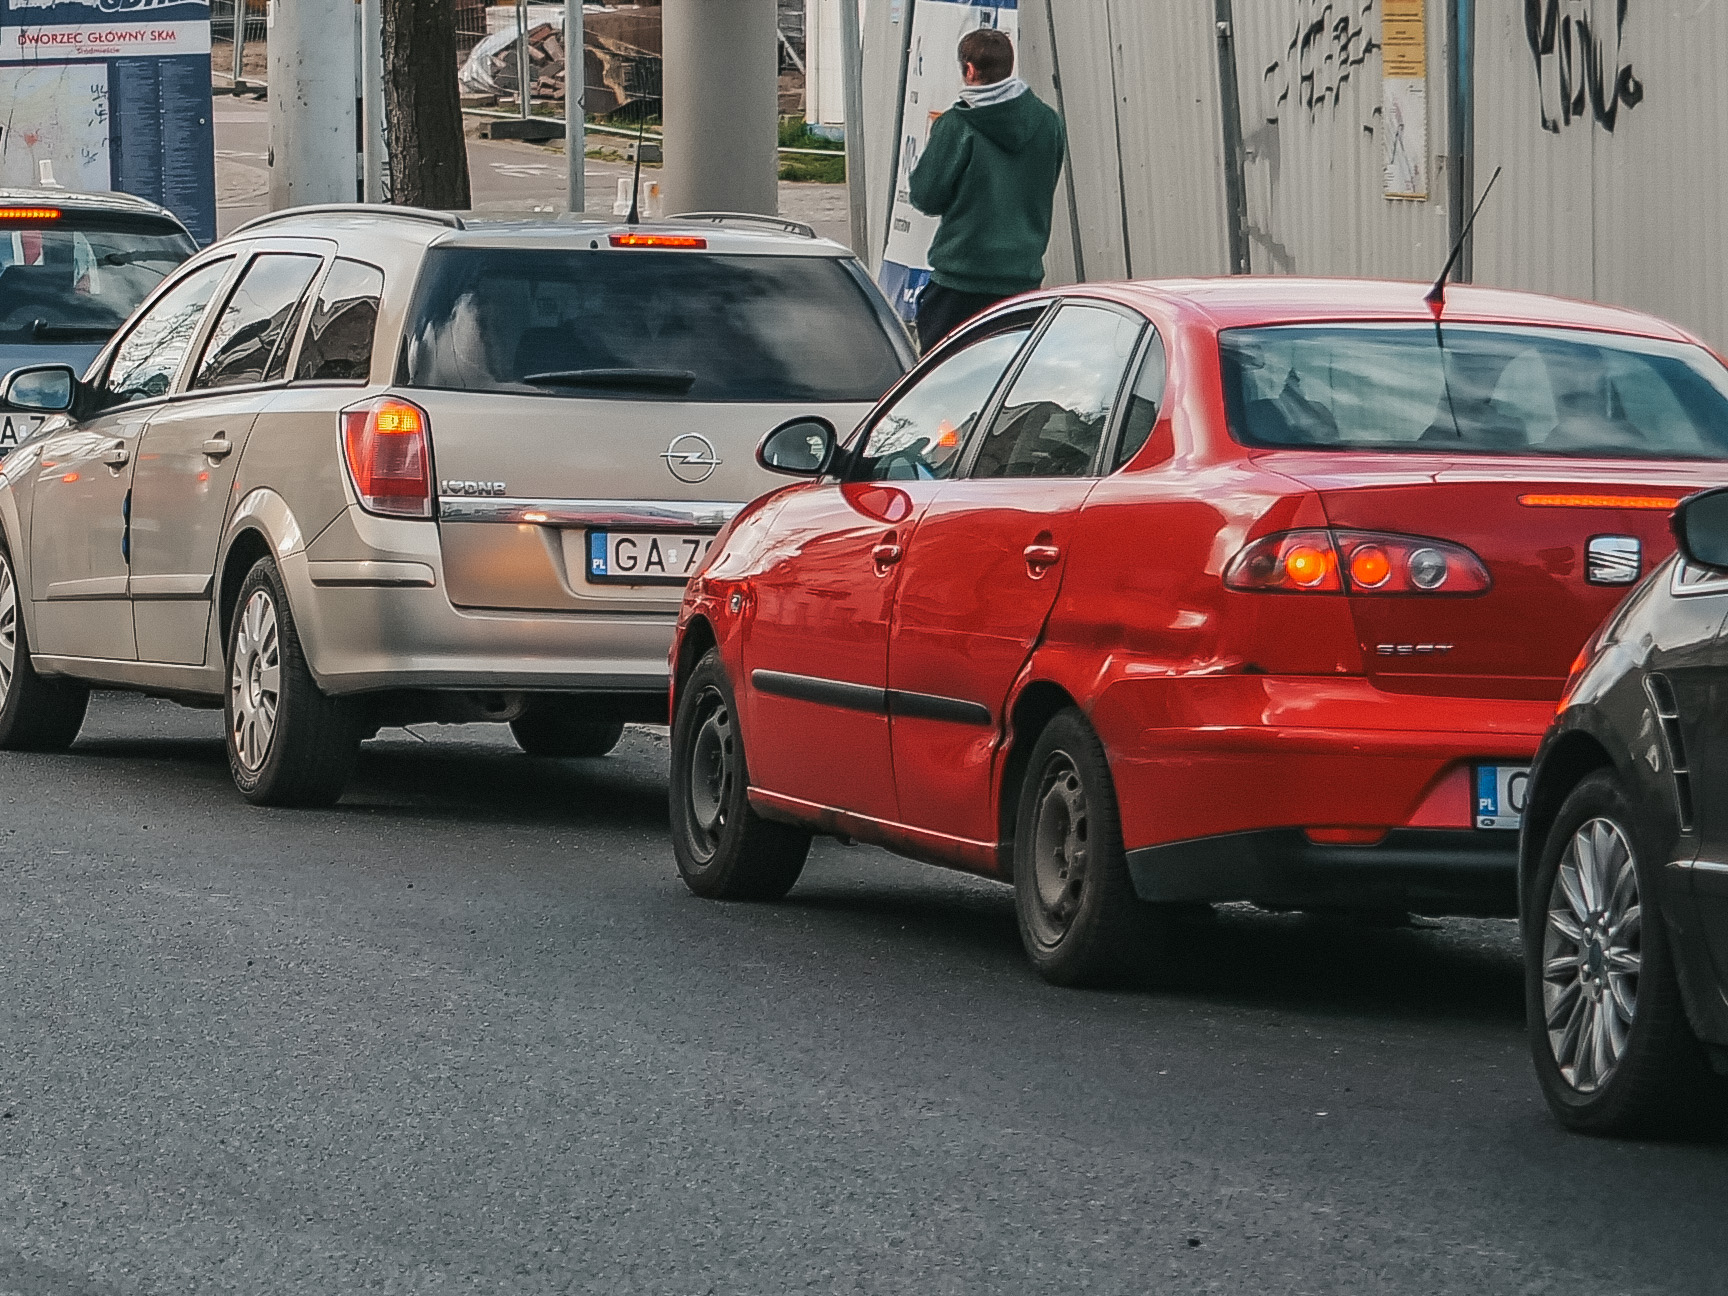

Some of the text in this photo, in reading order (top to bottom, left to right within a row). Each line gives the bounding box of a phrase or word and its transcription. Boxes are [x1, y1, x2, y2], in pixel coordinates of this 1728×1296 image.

[17, 30, 176, 46] DWORZEC GŁÓWNY SKM
[614, 537, 666, 573] GA
[1479, 798, 1495, 811] PL
